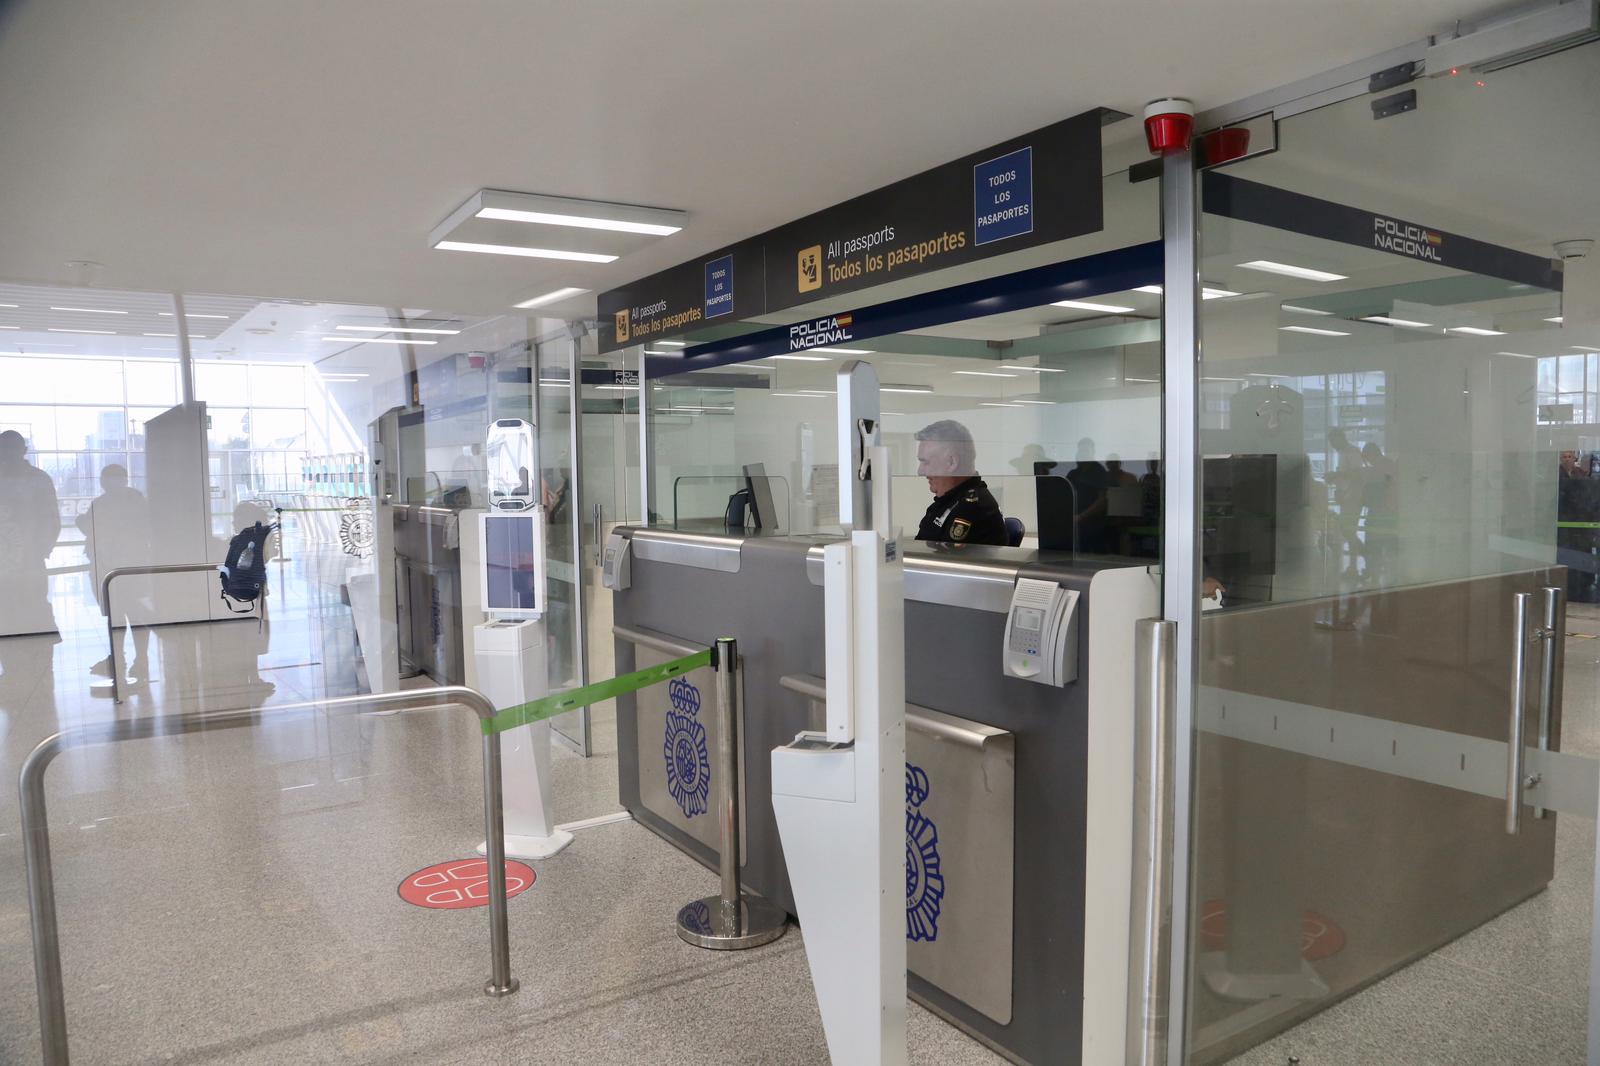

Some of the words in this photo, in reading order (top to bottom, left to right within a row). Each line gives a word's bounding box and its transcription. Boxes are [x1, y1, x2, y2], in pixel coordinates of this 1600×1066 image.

[988, 170, 1016, 187] TODOS
[994, 190, 1011, 204] LOS
[977, 204, 1029, 228] PASAPORTES
[827, 240, 840, 259] All
[843, 225, 895, 258] passports
[1374, 233, 1442, 261] NACIONAL
[827, 259, 862, 283] Todos
[865, 254, 883, 273] los
[887, 231, 966, 272] pasaportes
[711, 269, 726, 280] TODOS
[714, 282, 723, 292] LOS
[631, 306, 640, 320] All
[640, 299, 667, 320] passports
[706, 292, 732, 307] PASAPORTES
[631, 322, 650, 337] Todos
[651, 319, 661, 332] los
[662, 307, 702, 332] pasaportes
[789, 328, 853, 350] NACIONAL
